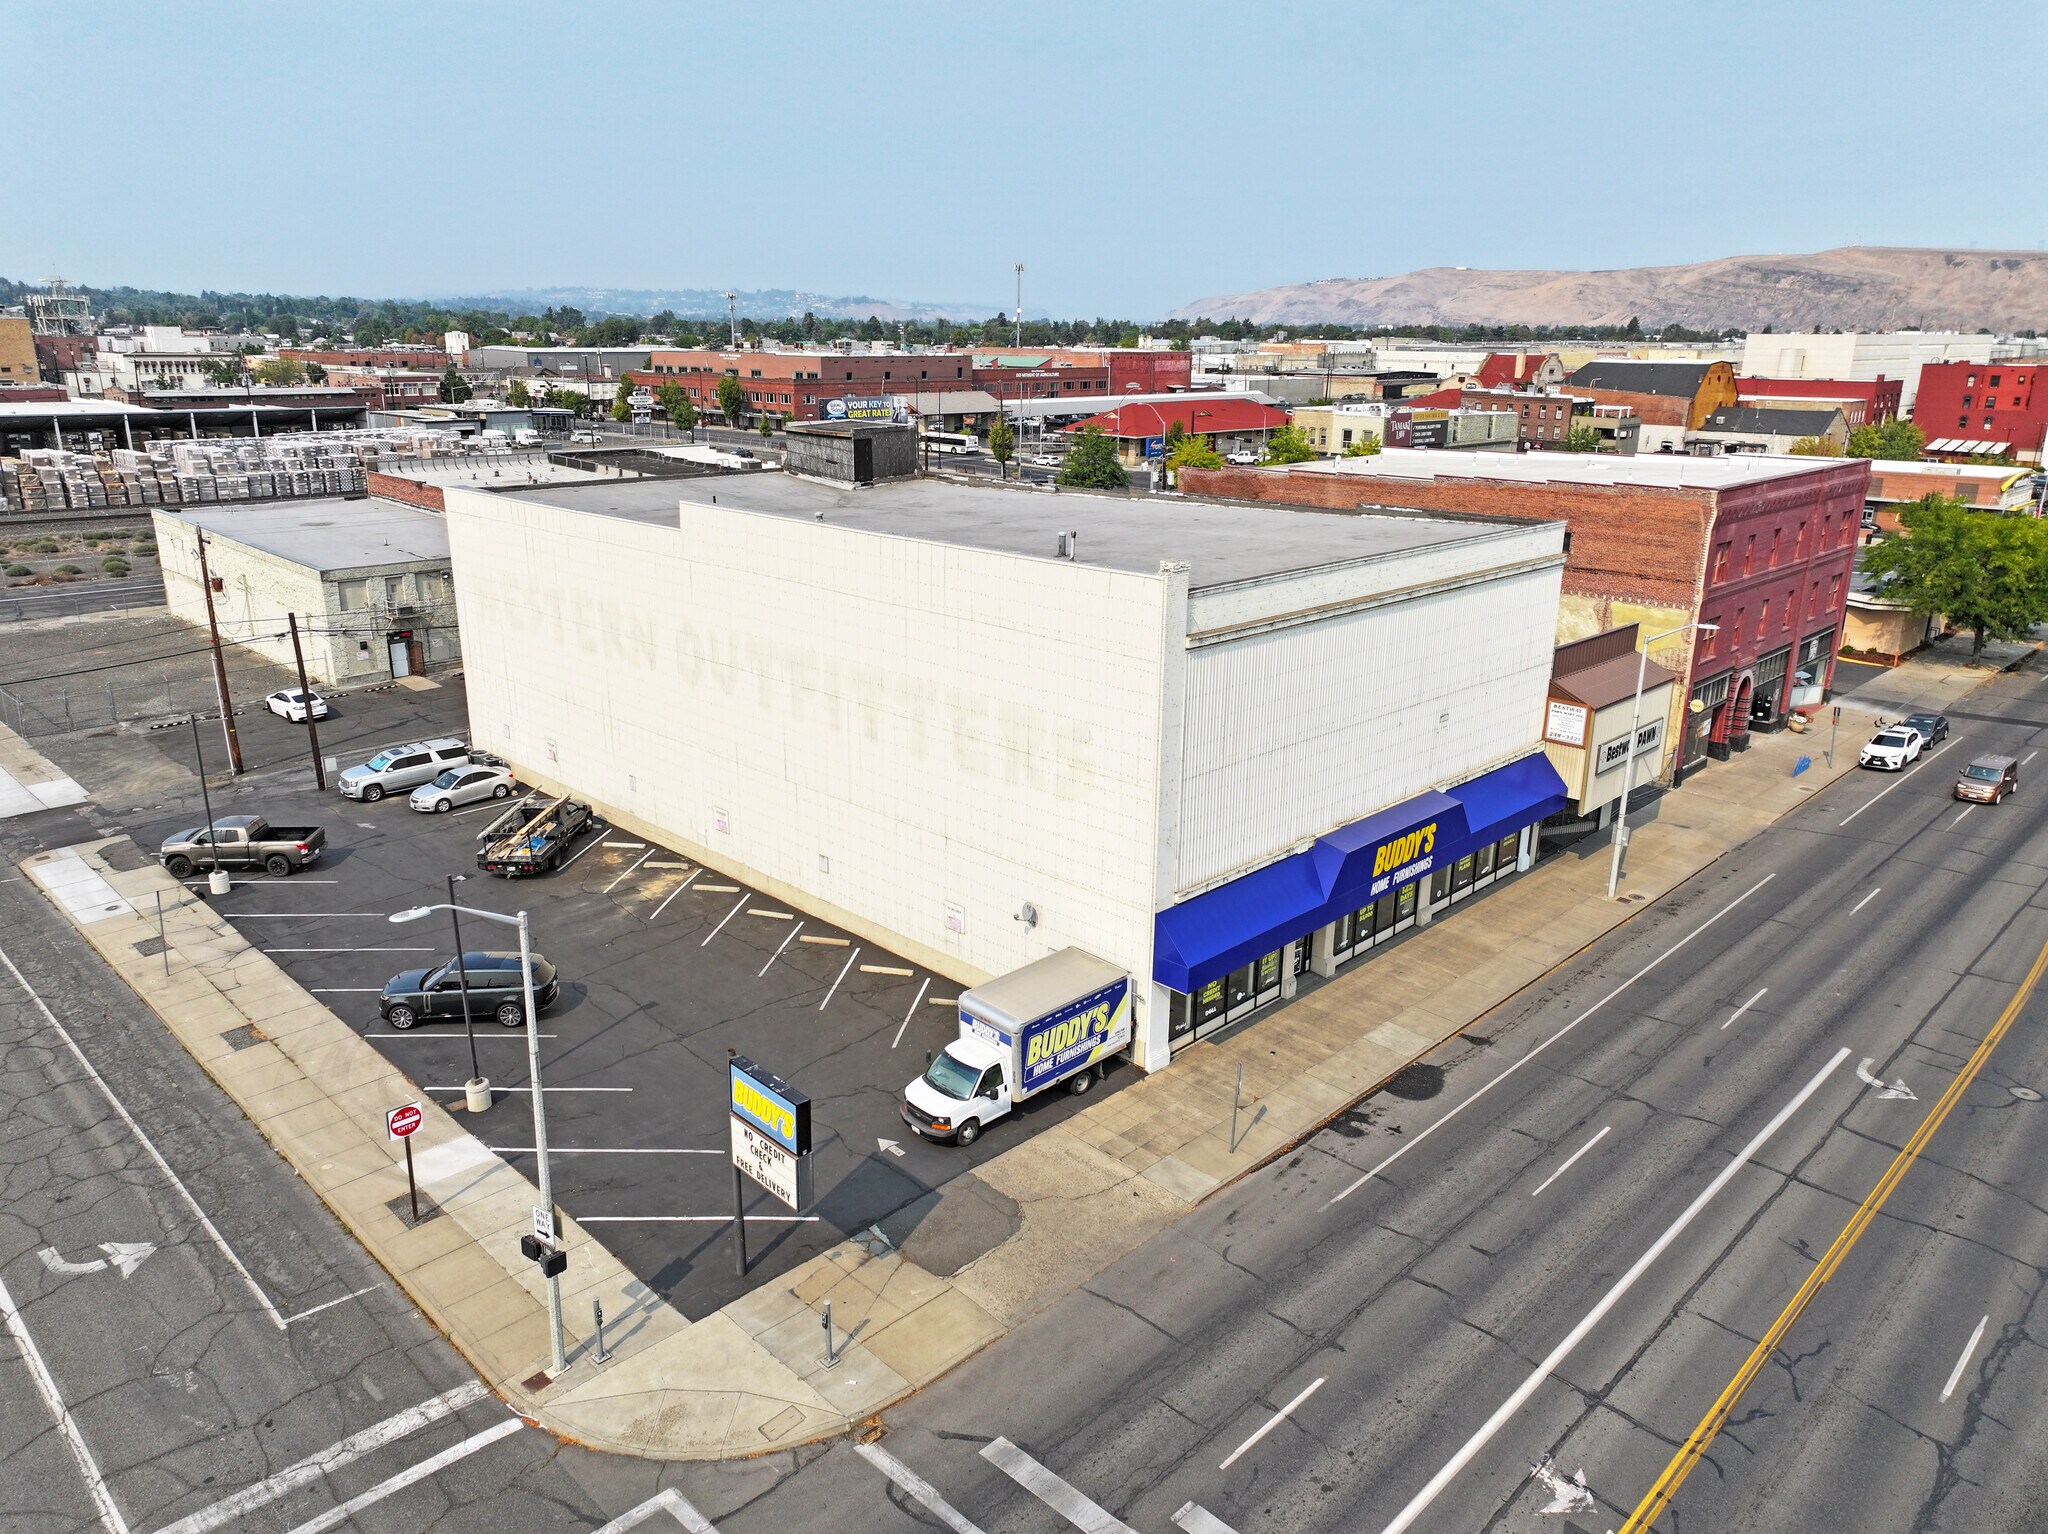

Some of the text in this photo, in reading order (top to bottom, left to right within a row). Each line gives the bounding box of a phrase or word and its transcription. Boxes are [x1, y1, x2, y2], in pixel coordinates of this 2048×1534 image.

[848, 401, 867, 409] YOUR
[848, 410, 870, 418] GREAT
[1396, 430, 1405, 439] LAW
[1553, 704, 1582, 713] BESTWAY
[1637, 726, 1657, 748] PAWN
[1372, 822, 1437, 878] BUDDY'S
[1370, 875, 1391, 896] HOME
[1392, 857, 1432, 886] FURNISHINGS
[1360, 907, 1366, 915] UP
[1207, 980, 1217, 989] NO
[1203, 985, 1221, 998] CREDIT
[1203, 992, 1221, 1004] NEEDED
[972, 1018, 1000, 1041] BUDDY'S
[1027, 1002, 1109, 1067] BUDDY'S
[1033, 1057, 1054, 1077] HOME
[1056, 1034, 1101, 1065] FURNISHINGS
[405, 1109, 416, 1118] NOT
[733, 1078, 795, 1138] BUDDY'S
[397, 1122, 416, 1133] ENTER
[744, 1128, 785, 1163] NO CREDIT
[750, 1144, 772, 1167] CHECK
[736, 1155, 791, 1202] FREE DELIVERY
[536, 1210, 549, 1222] ONE
[536, 1218, 550, 1230] WAY
